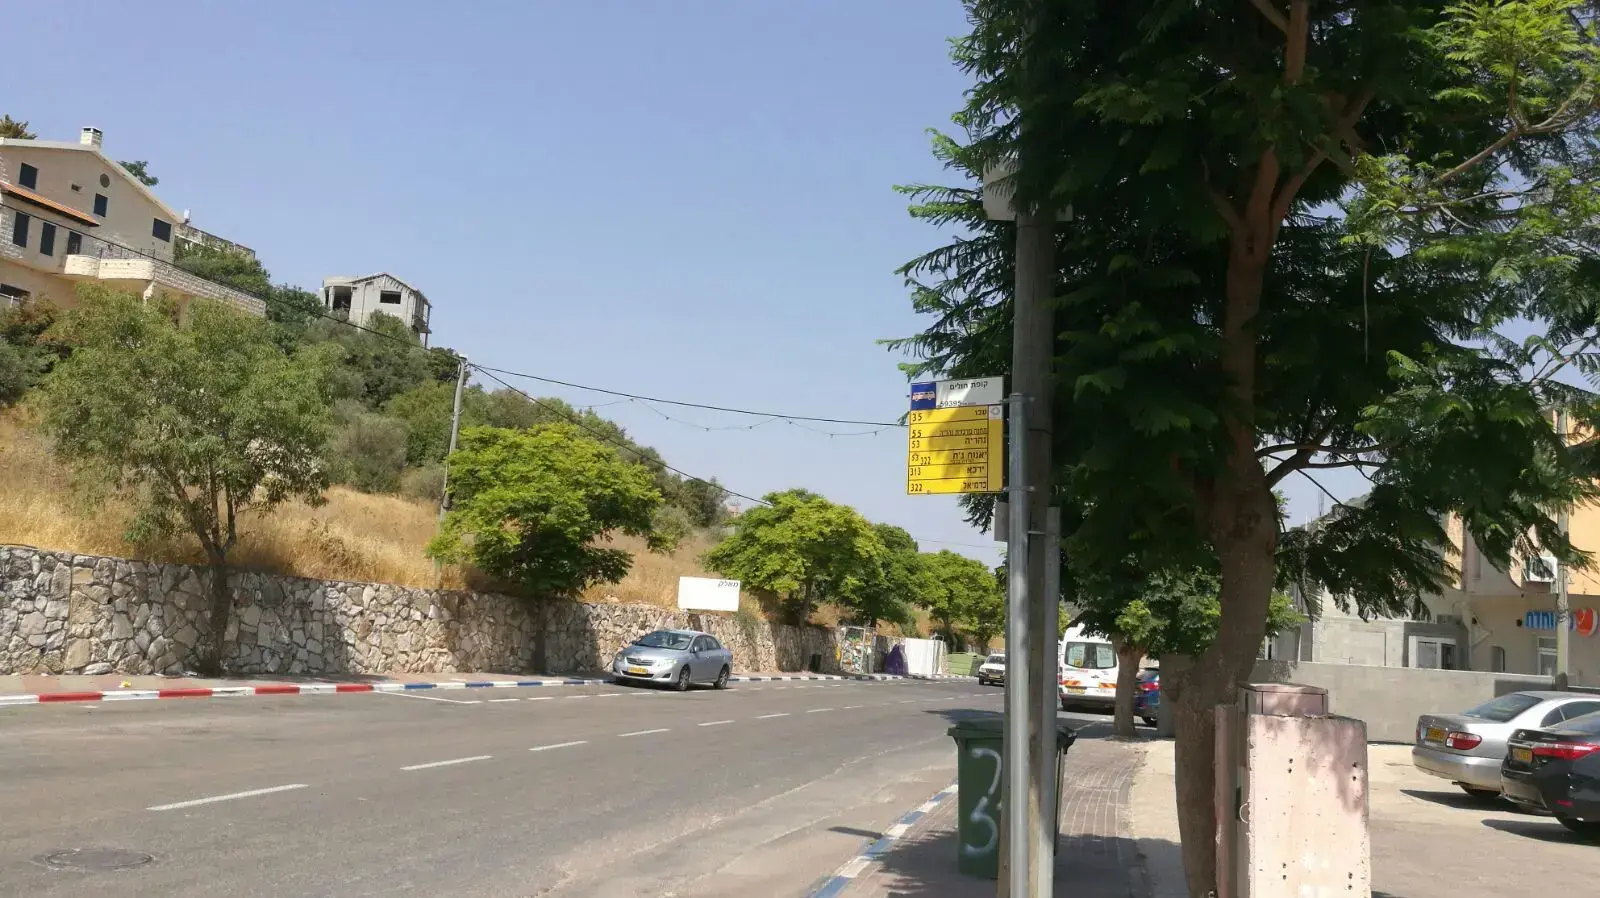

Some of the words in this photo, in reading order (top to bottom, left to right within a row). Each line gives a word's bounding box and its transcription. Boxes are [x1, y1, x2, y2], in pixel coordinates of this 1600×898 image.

[949, 382, 968, 390] חולים
[970, 381, 988, 389] קופת
[912, 412, 922, 422] 35
[912, 430, 922, 438] 55
[911, 440, 920, 449] 53
[965, 436, 987, 445] נהריה
[910, 467, 921, 476] 313
[910, 483, 923, 492] 322
[963, 481, 986, 489] כרמיאל
